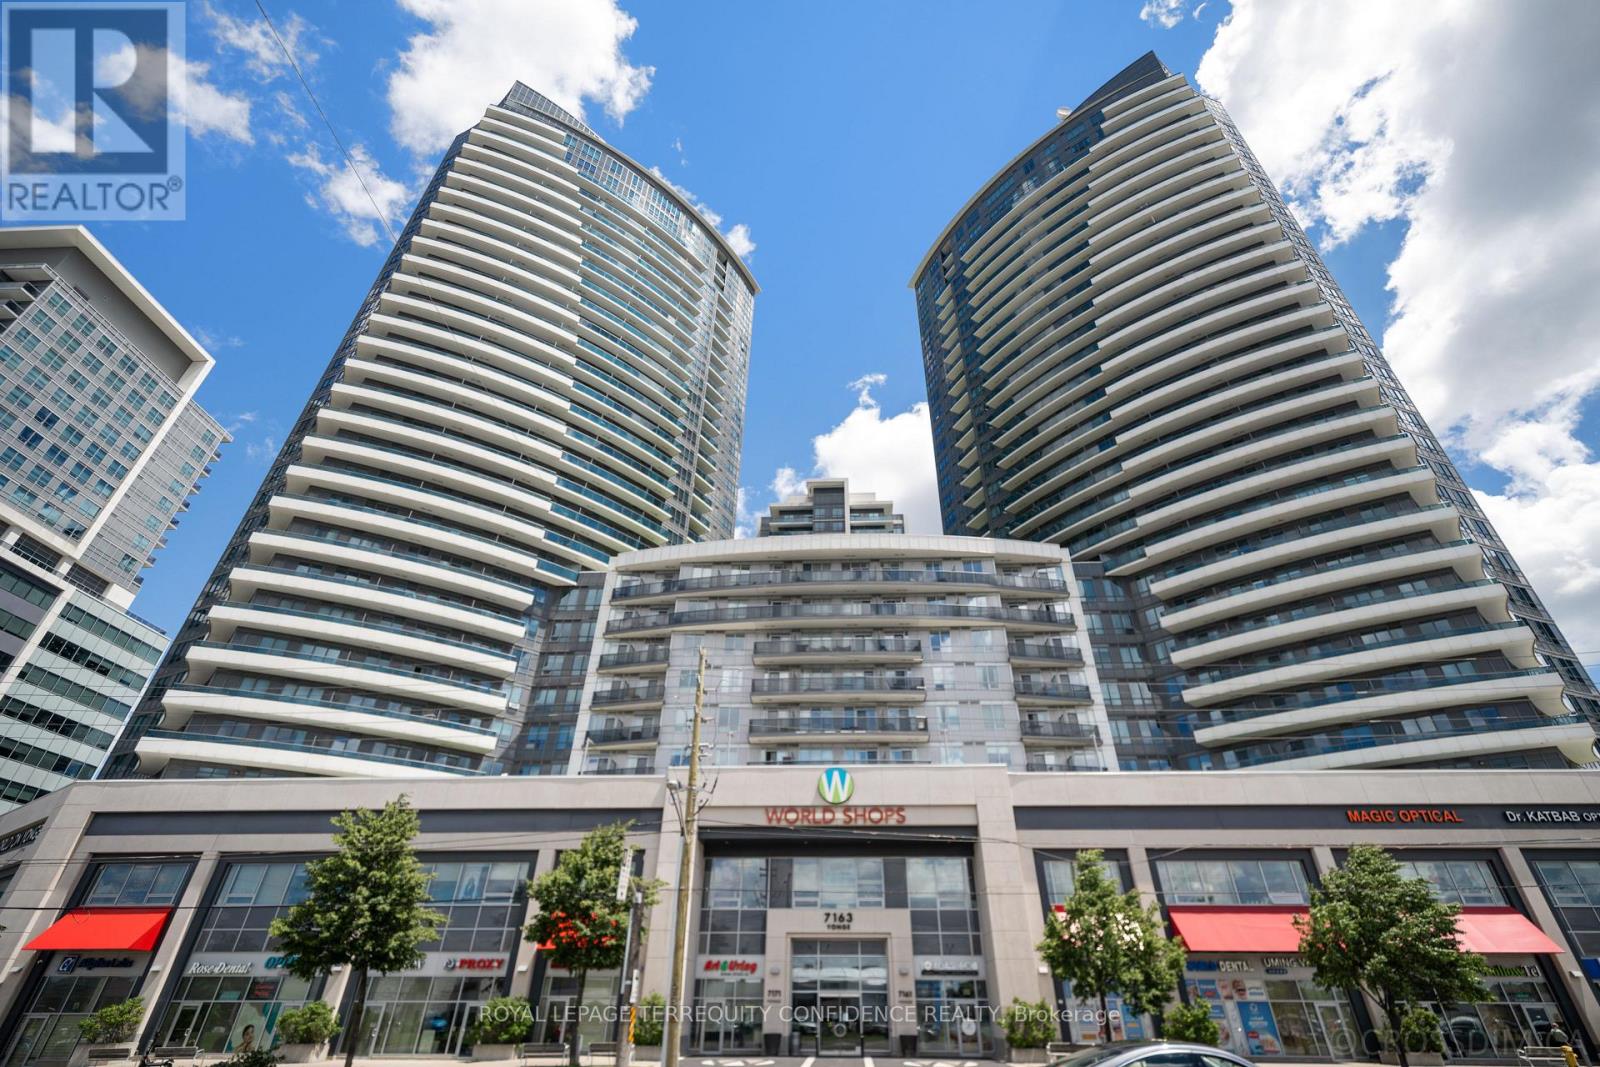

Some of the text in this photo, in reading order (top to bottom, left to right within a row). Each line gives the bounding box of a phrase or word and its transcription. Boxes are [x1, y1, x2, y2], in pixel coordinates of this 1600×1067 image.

[765, 806, 906, 825] WORLD SHOPS
[1347, 809, 1465, 823] MAGIC OPTICAL
[1505, 810, 1527, 822] Dr.
[1526, 810, 1581, 822] KATBAB
[824, 912, 853, 923] 7163
[188, 961, 214, 974] Rose
[214, 961, 252, 974] Dental
[458, 958, 505, 970] PROXY
